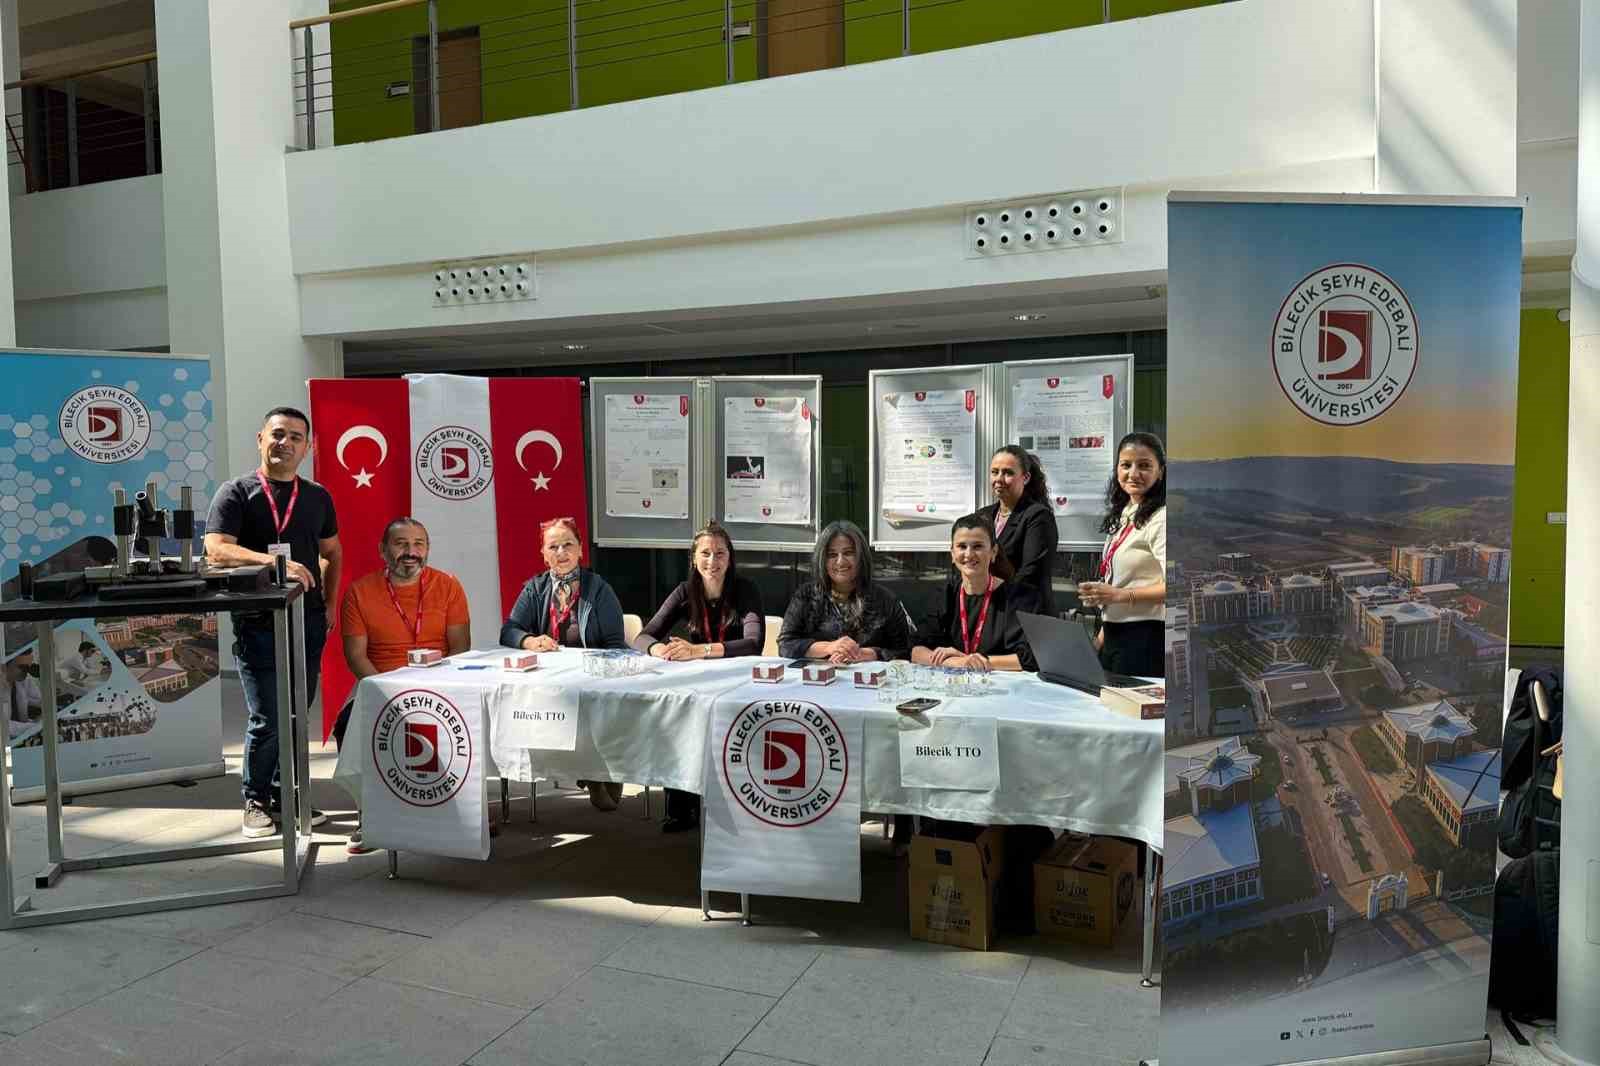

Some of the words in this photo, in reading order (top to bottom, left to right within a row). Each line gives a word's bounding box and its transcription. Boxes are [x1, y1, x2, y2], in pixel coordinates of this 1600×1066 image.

[1278, 286, 1320, 352] BİLECİK
[1321, 274, 1366, 294] ŞEYH
[1368, 281, 1413, 351] EDEBALİ
[1292, 375, 1399, 418] ÜNİVERSİTESİ
[376, 703, 403, 752] BİLECİK
[403, 696, 433, 711] ŞEYH
[435, 702, 468, 757] EDEBALİ
[513, 711, 542, 720] Bilecik
[545, 711, 566, 720] TTO
[729, 708, 763, 763] BİLECİK
[764, 702, 802, 717] ŞEYH
[803, 708, 842, 772] EDEBALİ
[916, 745, 952, 757] Bilecik
[955, 746, 982, 758] TTO
[387, 767, 459, 800] ÜNİVERSİTESİ
[740, 782, 831, 819] ÜNİVERSİTESİ
